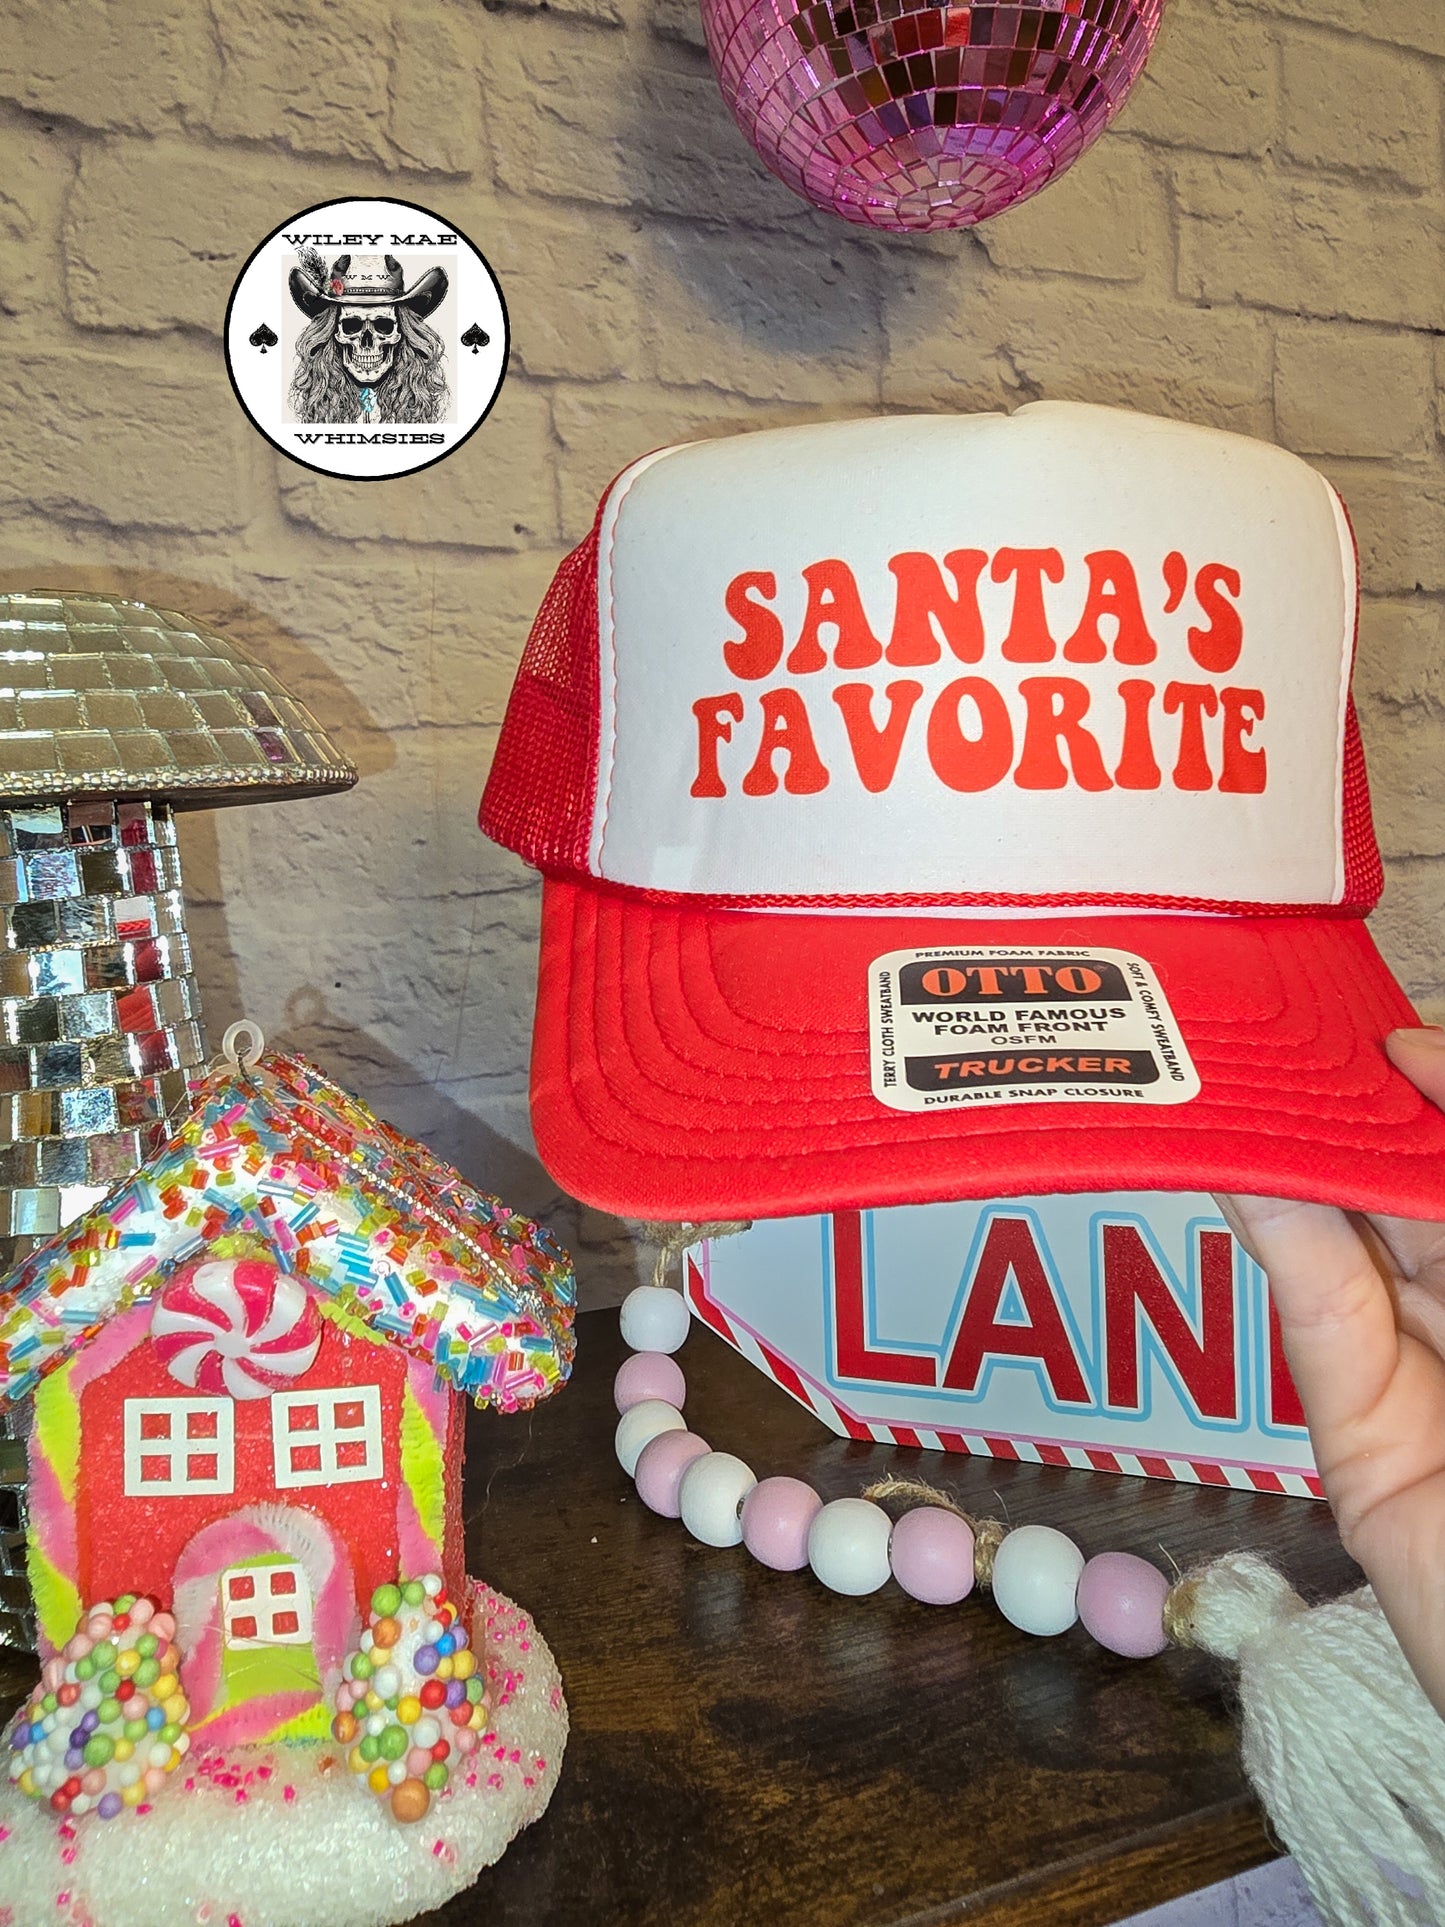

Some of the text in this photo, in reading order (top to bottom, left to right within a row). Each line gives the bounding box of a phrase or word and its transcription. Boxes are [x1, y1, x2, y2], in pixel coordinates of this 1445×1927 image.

[723, 547, 1244, 681] SANTA'S
[690, 676, 1268, 798] FAVORITE
[915, 950, 985, 959] PREMIUM
[921, 966, 1102, 997] OTTO
[912, 1007, 1127, 1024] WORLD FAMOUS
[1126, 962, 1146, 981] SOFT
[1138, 990, 1162, 1022] COMFY
[1151, 1023, 1185, 1082] SWEATBAND
[879, 971, 898, 1088] TERRY CLOTH SWEATBAND
[934, 1021, 1109, 1036] FOAM FRONT
[990, 1035, 1058, 1046] OSFM
[934, 1056, 1133, 1081] TRUCKER
[923, 1088, 1145, 1106] DURABLE SNAP CLOSURE
